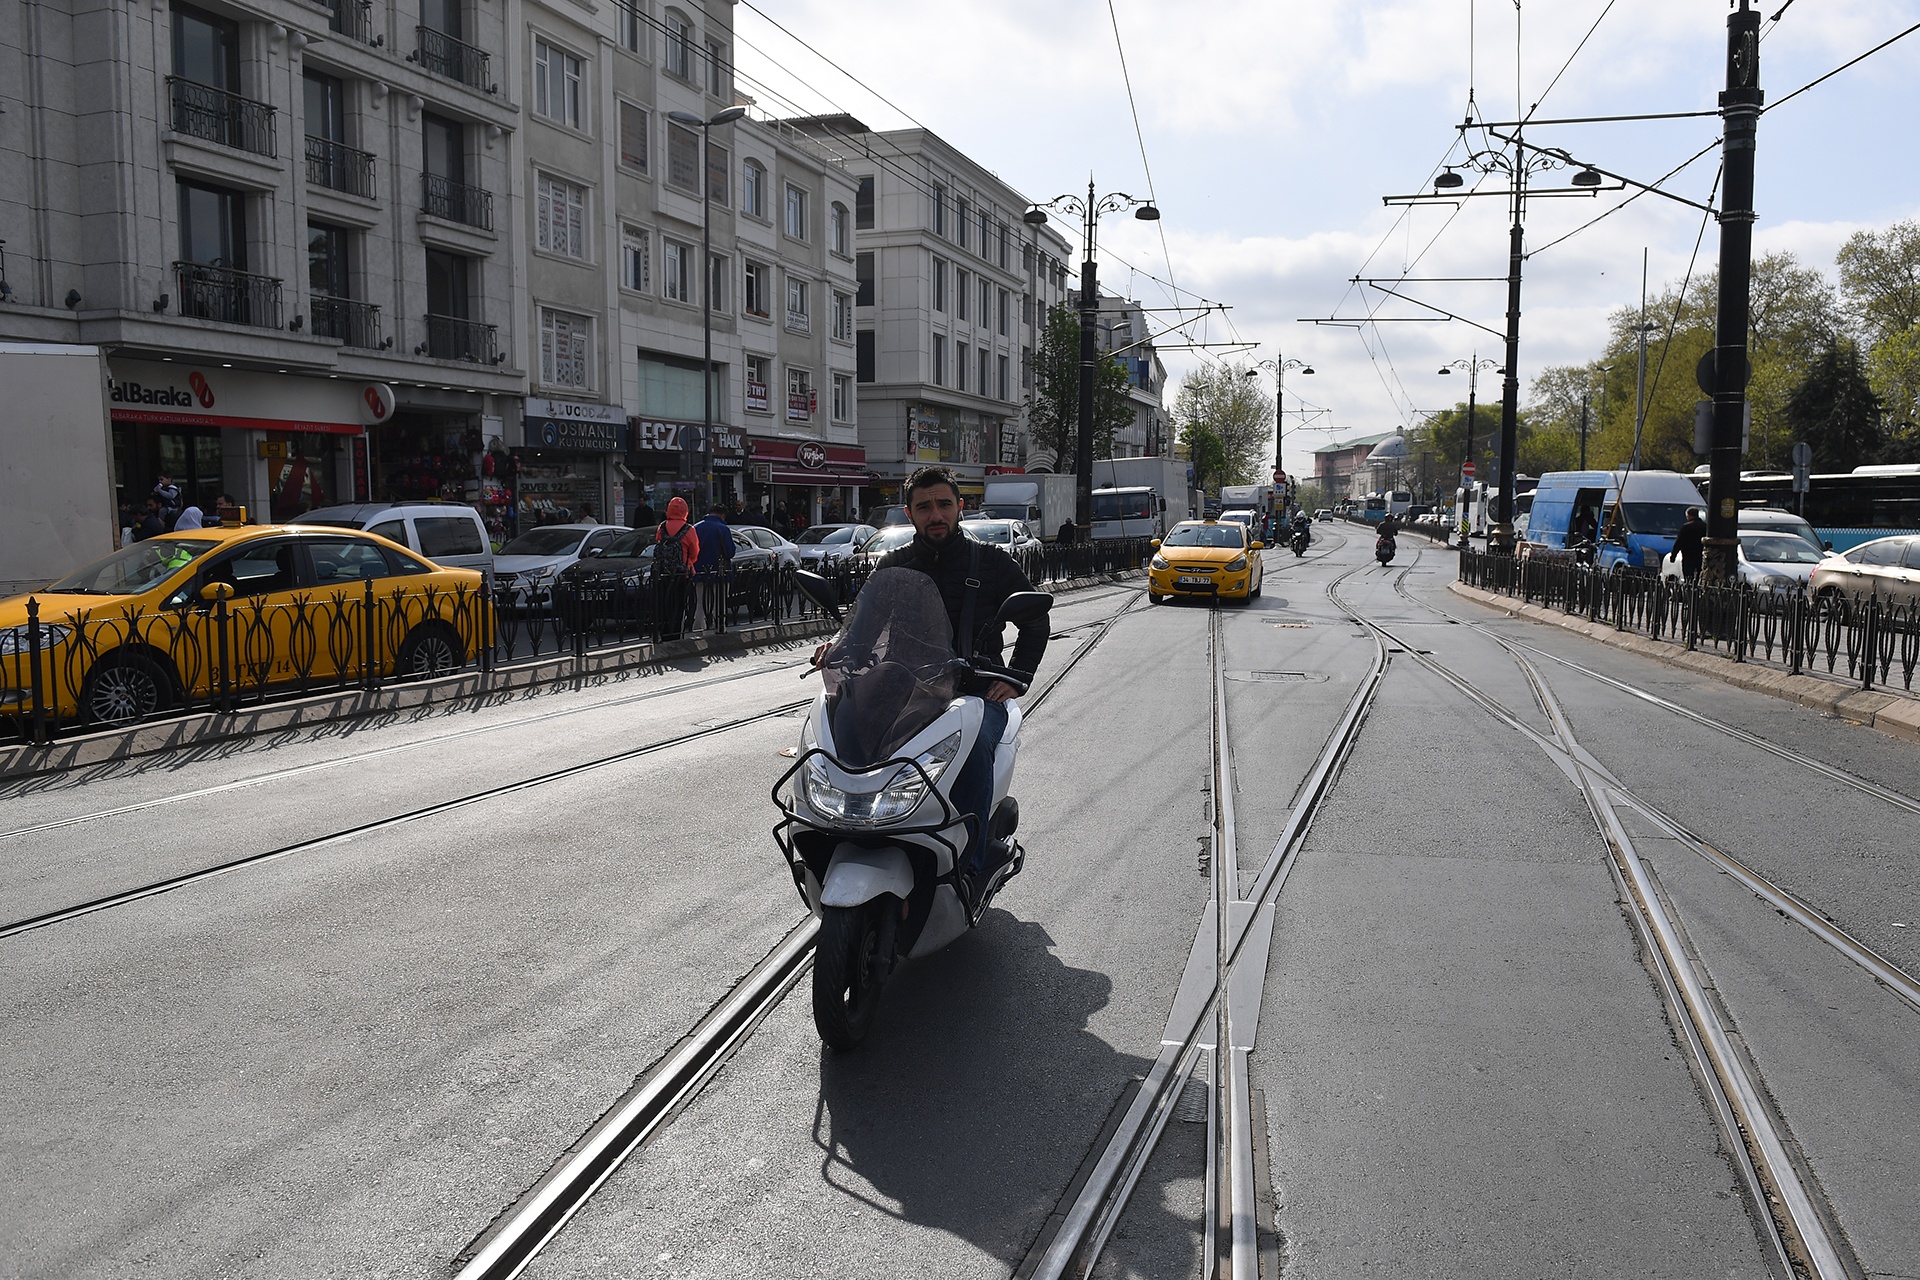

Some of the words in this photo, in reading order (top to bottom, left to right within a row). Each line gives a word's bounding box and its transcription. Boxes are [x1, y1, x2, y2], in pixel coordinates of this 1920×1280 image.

[752, 384, 766, 397] THY
[924, 407, 935, 416] SALE
[559, 422, 617, 439] OSMANLI
[559, 438, 617, 450] KUYUMCUSU
[719, 433, 742, 449] HALK
[713, 458, 744, 467] PHARMACY
[521, 483, 547, 492] SILVER
[276, 660, 290, 673] 14
